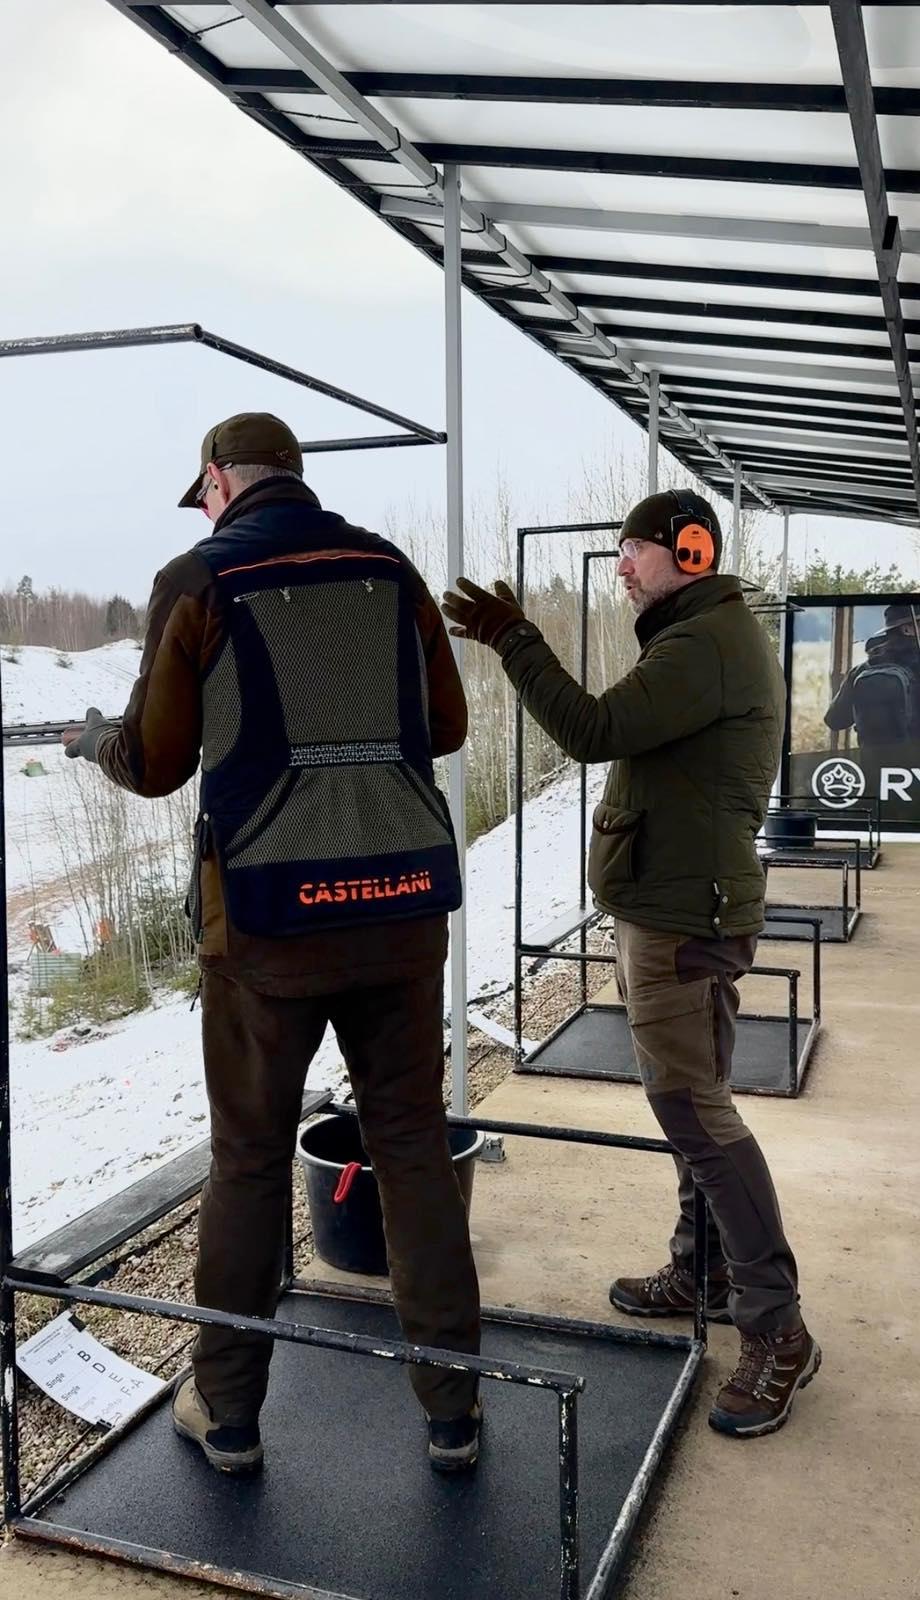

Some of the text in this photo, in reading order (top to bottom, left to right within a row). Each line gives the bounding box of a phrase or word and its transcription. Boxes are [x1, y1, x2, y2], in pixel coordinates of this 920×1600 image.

[880, 767, 920, 801] R
[299, 871, 431, 904] CASTELLANI
[46, 1350, 91, 1388] Single B
[61, 1362, 106, 1401] Single D
[108, 1372, 123, 1383] E
